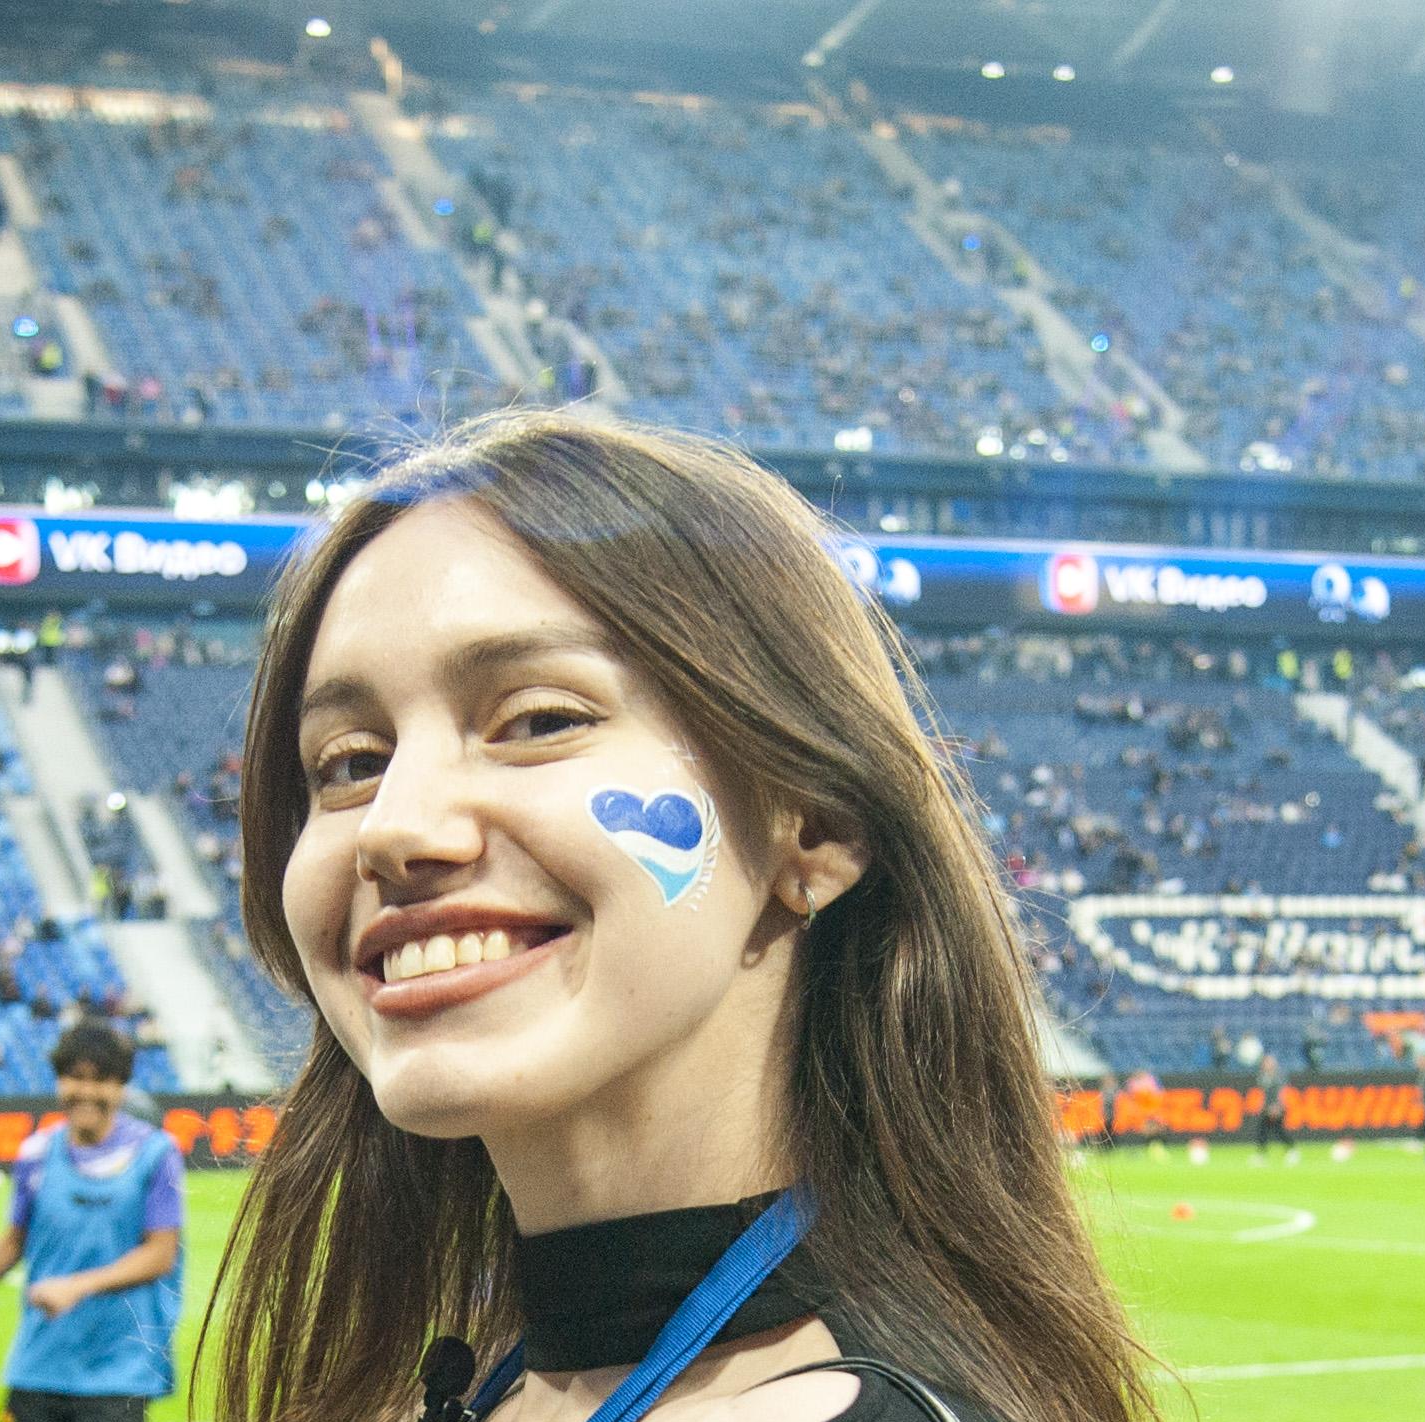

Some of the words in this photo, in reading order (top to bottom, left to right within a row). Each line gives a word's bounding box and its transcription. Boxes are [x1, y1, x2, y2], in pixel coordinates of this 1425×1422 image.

[47, 529, 113, 573] VK
[114, 531, 248, 581] Видео
[1104, 565, 1157, 604] VK
[1157, 566, 1267, 613] Видео
